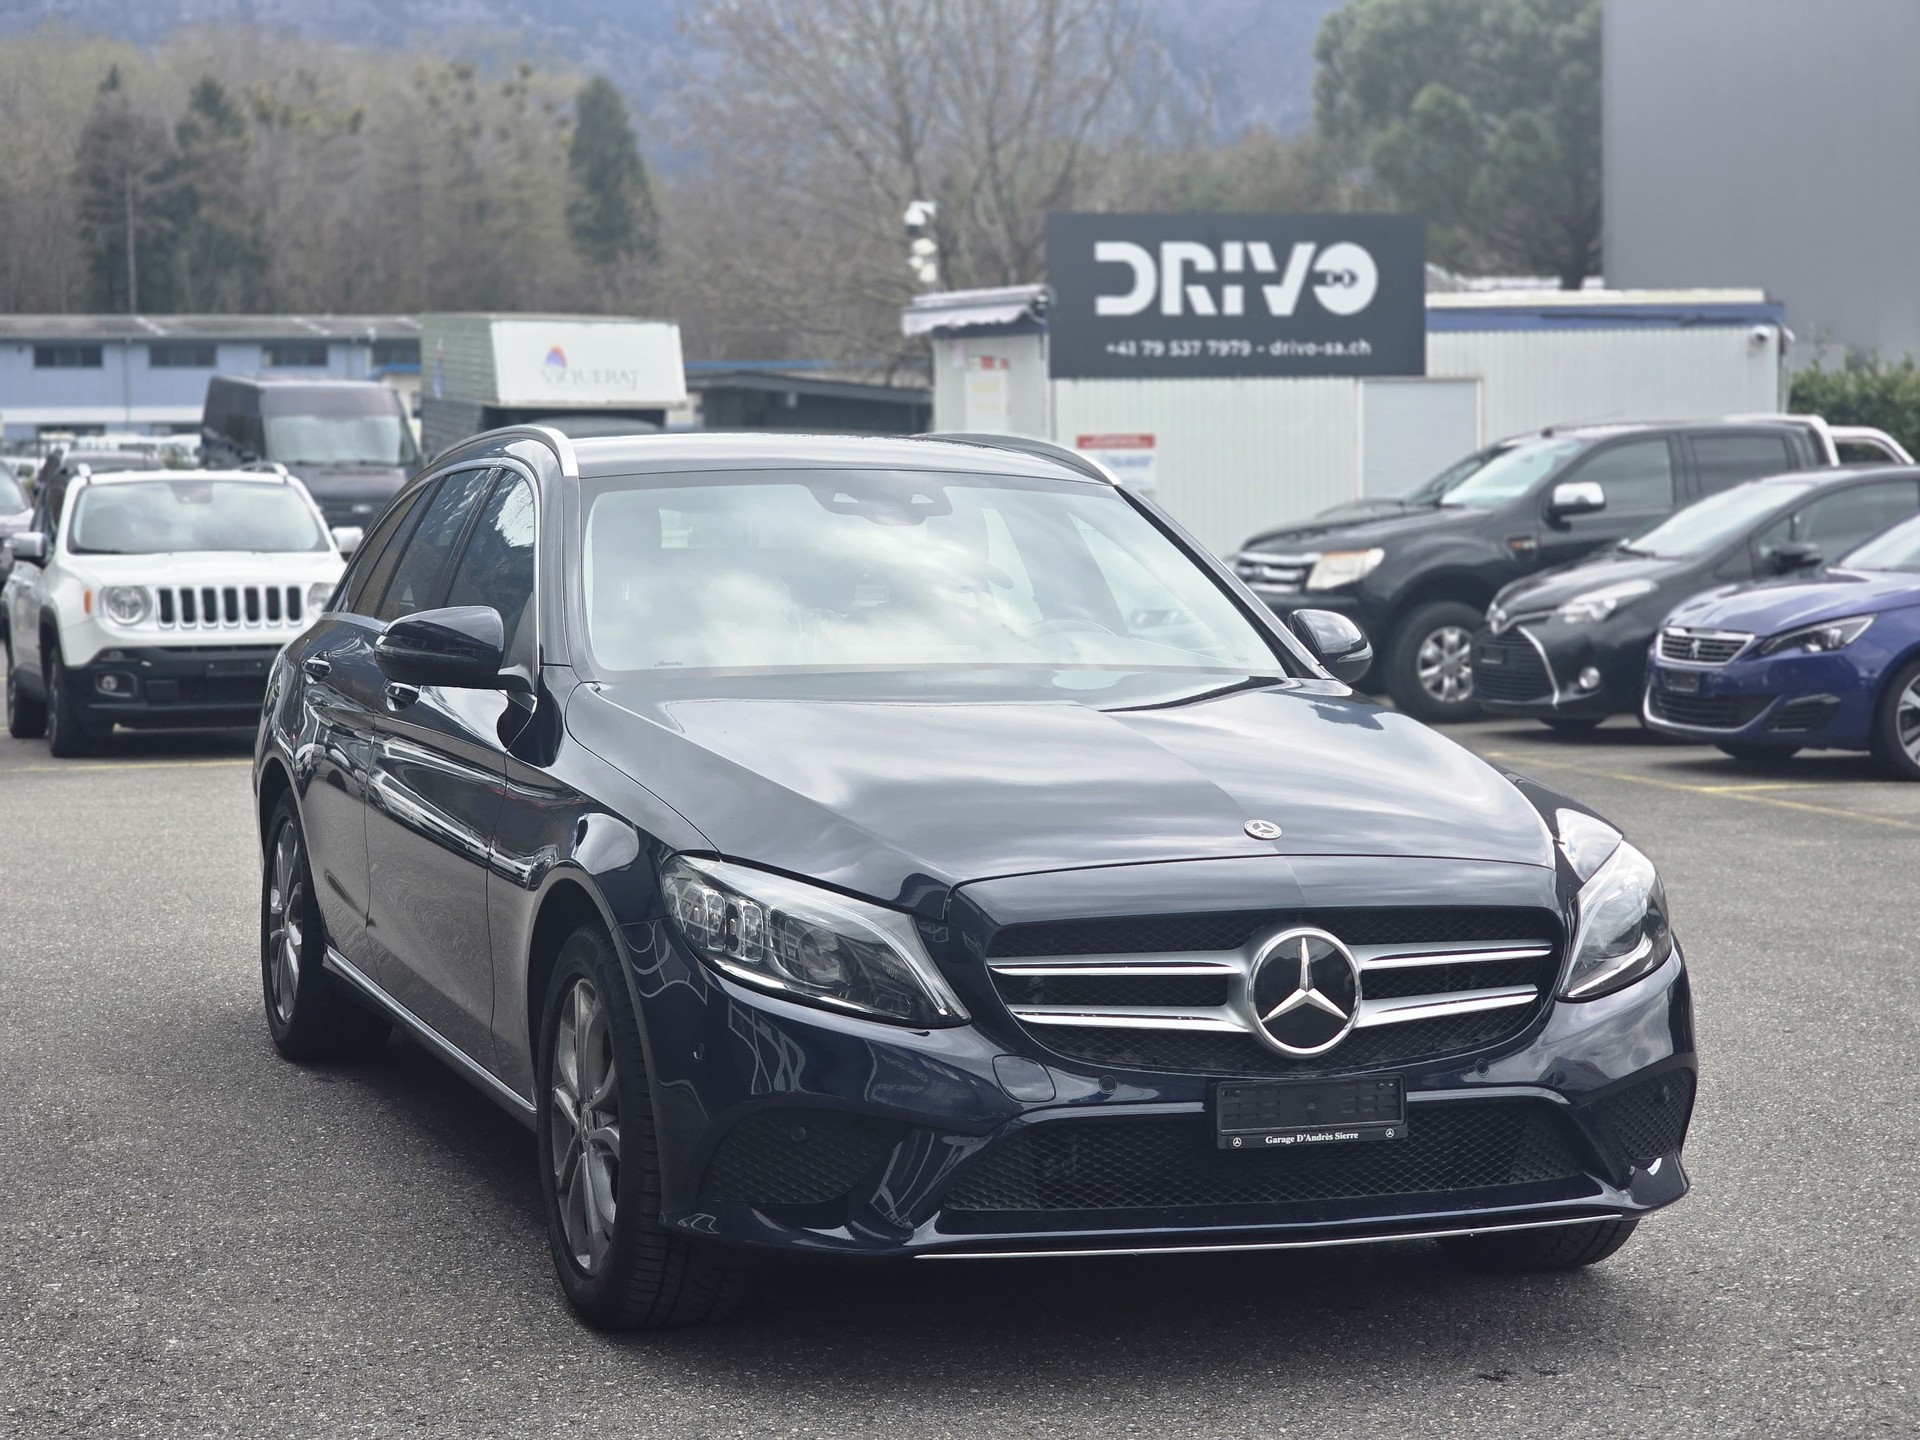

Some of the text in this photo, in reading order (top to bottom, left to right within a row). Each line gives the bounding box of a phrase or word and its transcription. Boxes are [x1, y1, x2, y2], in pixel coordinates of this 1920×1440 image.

[1094, 241, 1378, 316] DRIVO
[1105, 340, 1136, 357] +41
[1140, 340, 1165, 357] 79
[1265, 1136, 1295, 1144] Garage
[1334, 1131, 1358, 1140] Sierre
